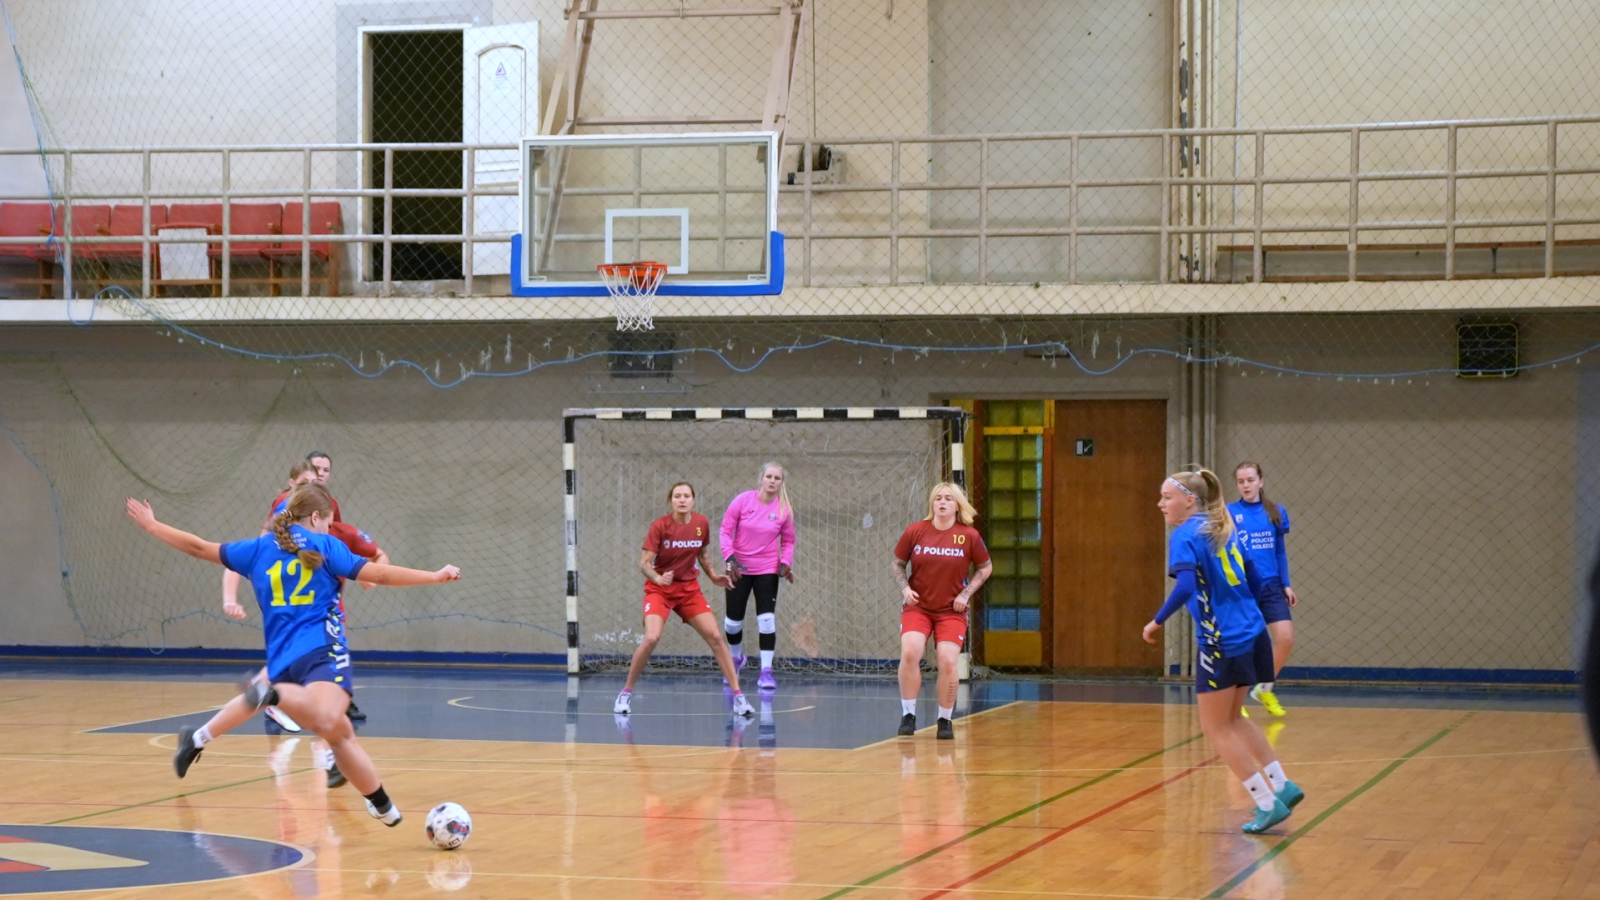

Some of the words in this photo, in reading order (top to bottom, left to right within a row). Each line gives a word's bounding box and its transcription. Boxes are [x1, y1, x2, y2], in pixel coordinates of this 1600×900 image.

[695, 527, 702, 536] 3
[952, 534, 966, 545] 10
[923, 546, 965, 558] POLICIJA
[1216, 542, 1247, 587] 11
[265, 558, 316, 607] 12
